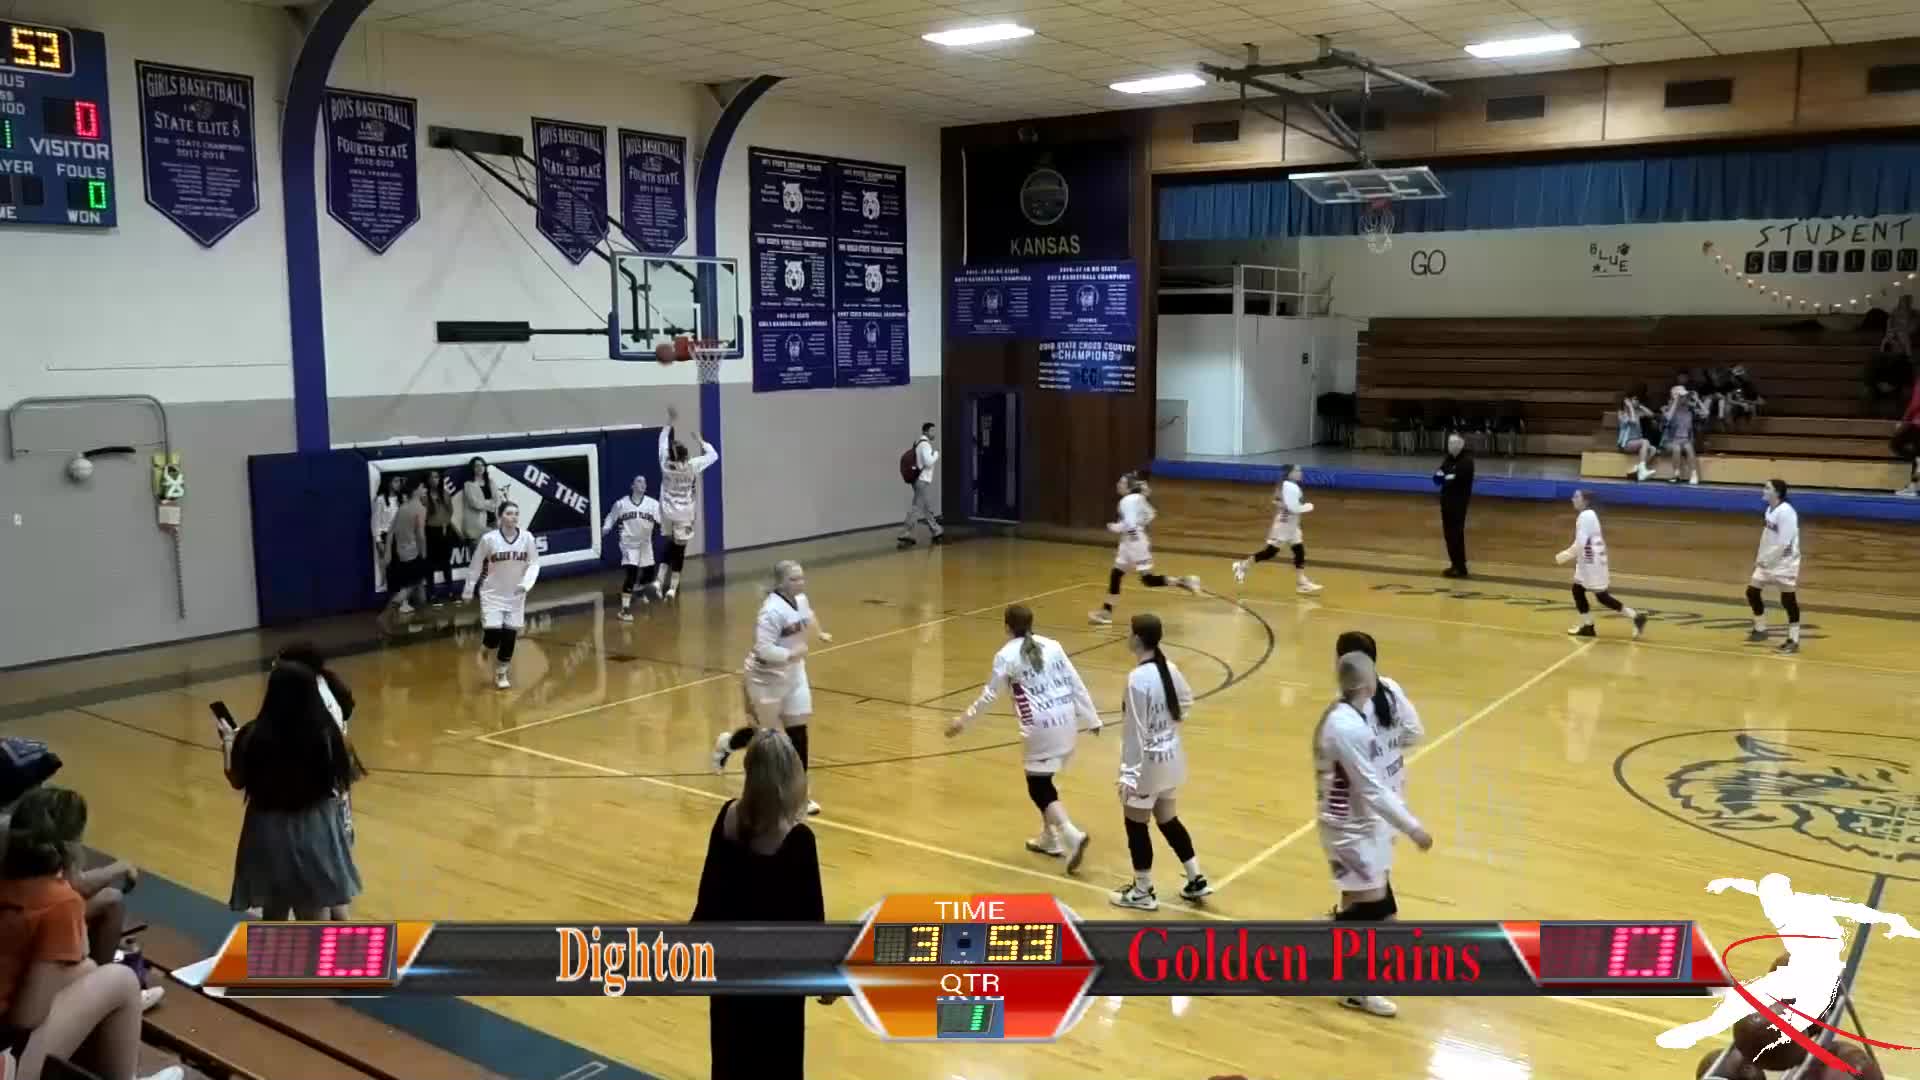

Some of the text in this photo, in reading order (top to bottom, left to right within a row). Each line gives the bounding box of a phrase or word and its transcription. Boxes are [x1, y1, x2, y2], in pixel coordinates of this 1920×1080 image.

[12, 27, 61, 69] 53
[147, 73, 246, 110] GIRLS BASKETBALL
[75, 101, 98, 137] 0
[154, 112, 240, 137] STATE ELITE 8
[355, 99, 411, 131] BASKETBALL
[29, 137, 110, 160] VISITOR
[337, 136, 409, 160] FOURTH STATE
[56, 163, 106, 179] FOULS
[88, 181, 107, 209] 0
[67, 209, 101, 224] WON
[1010, 235, 1081, 255] KANSAS
[1755, 217, 1912, 248] STUDENT
[1411, 250, 1446, 275] GO
[1747, 250, 1916, 273] SECTION
[1057, 341, 1076, 350] STATE
[1079, 341, 1102, 350] CROSS
[1103, 342, 1136, 353] COUNTRY
[1058, 350, 1115, 361] CHAMPIONS
[523, 464, 590, 514] OF THE
